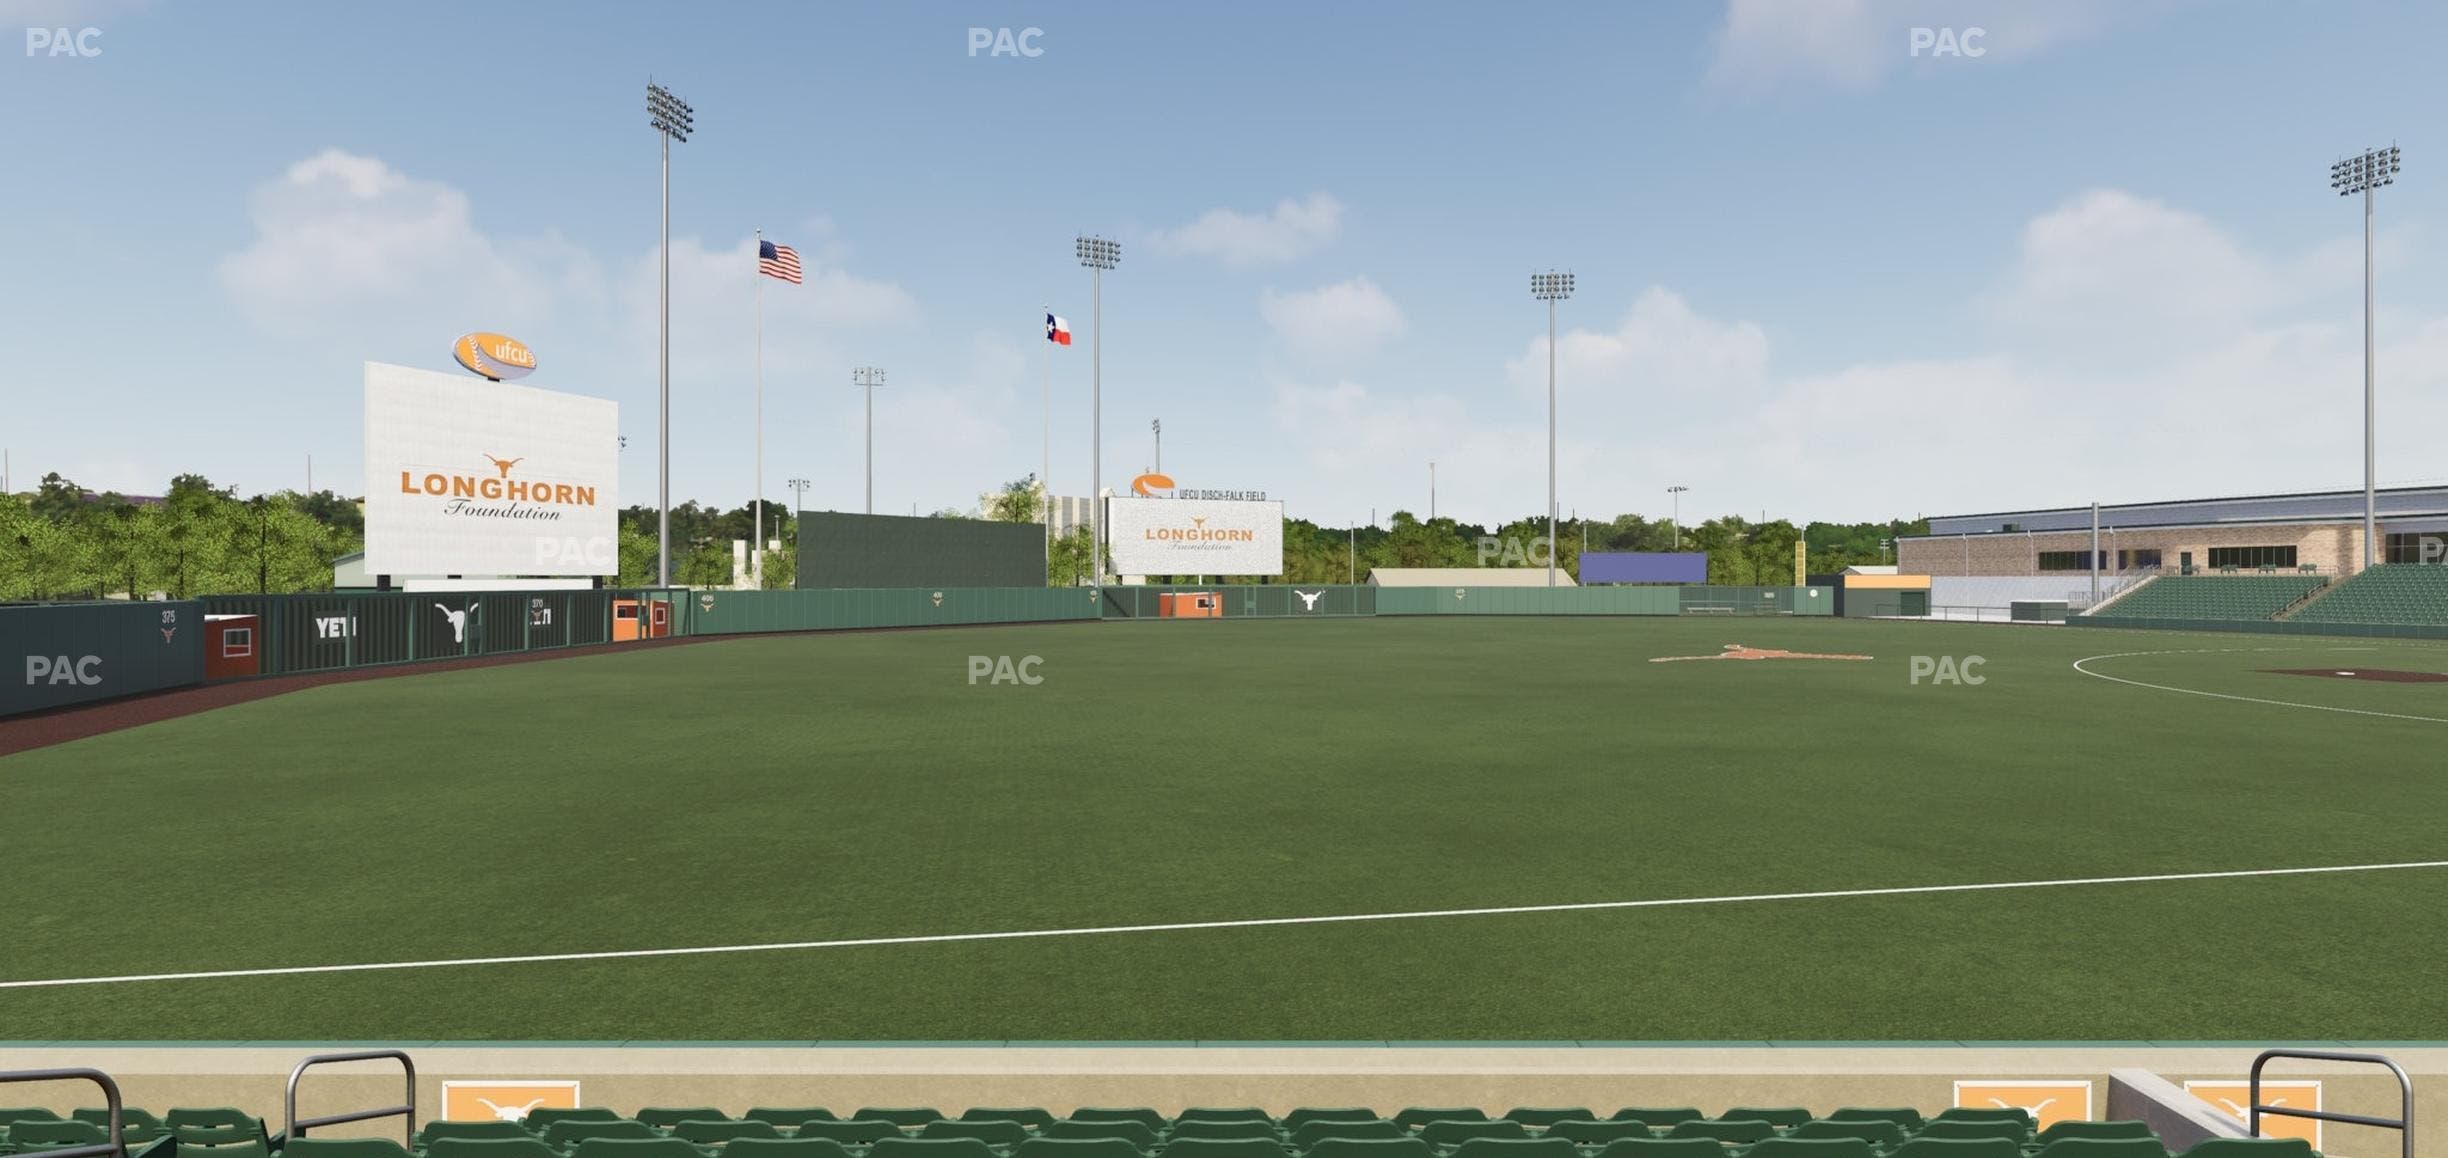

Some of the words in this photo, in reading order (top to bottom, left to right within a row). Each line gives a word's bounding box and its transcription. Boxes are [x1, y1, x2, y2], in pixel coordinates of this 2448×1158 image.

[495, 341, 528, 364] ufcu
[401, 471, 596, 507] LONGHORN
[1246, 490, 1266, 502] FIELD
[443, 498, 563, 522] Foundation
[1146, 528, 1254, 542] LONGHORN
[161, 609, 176, 624] 375
